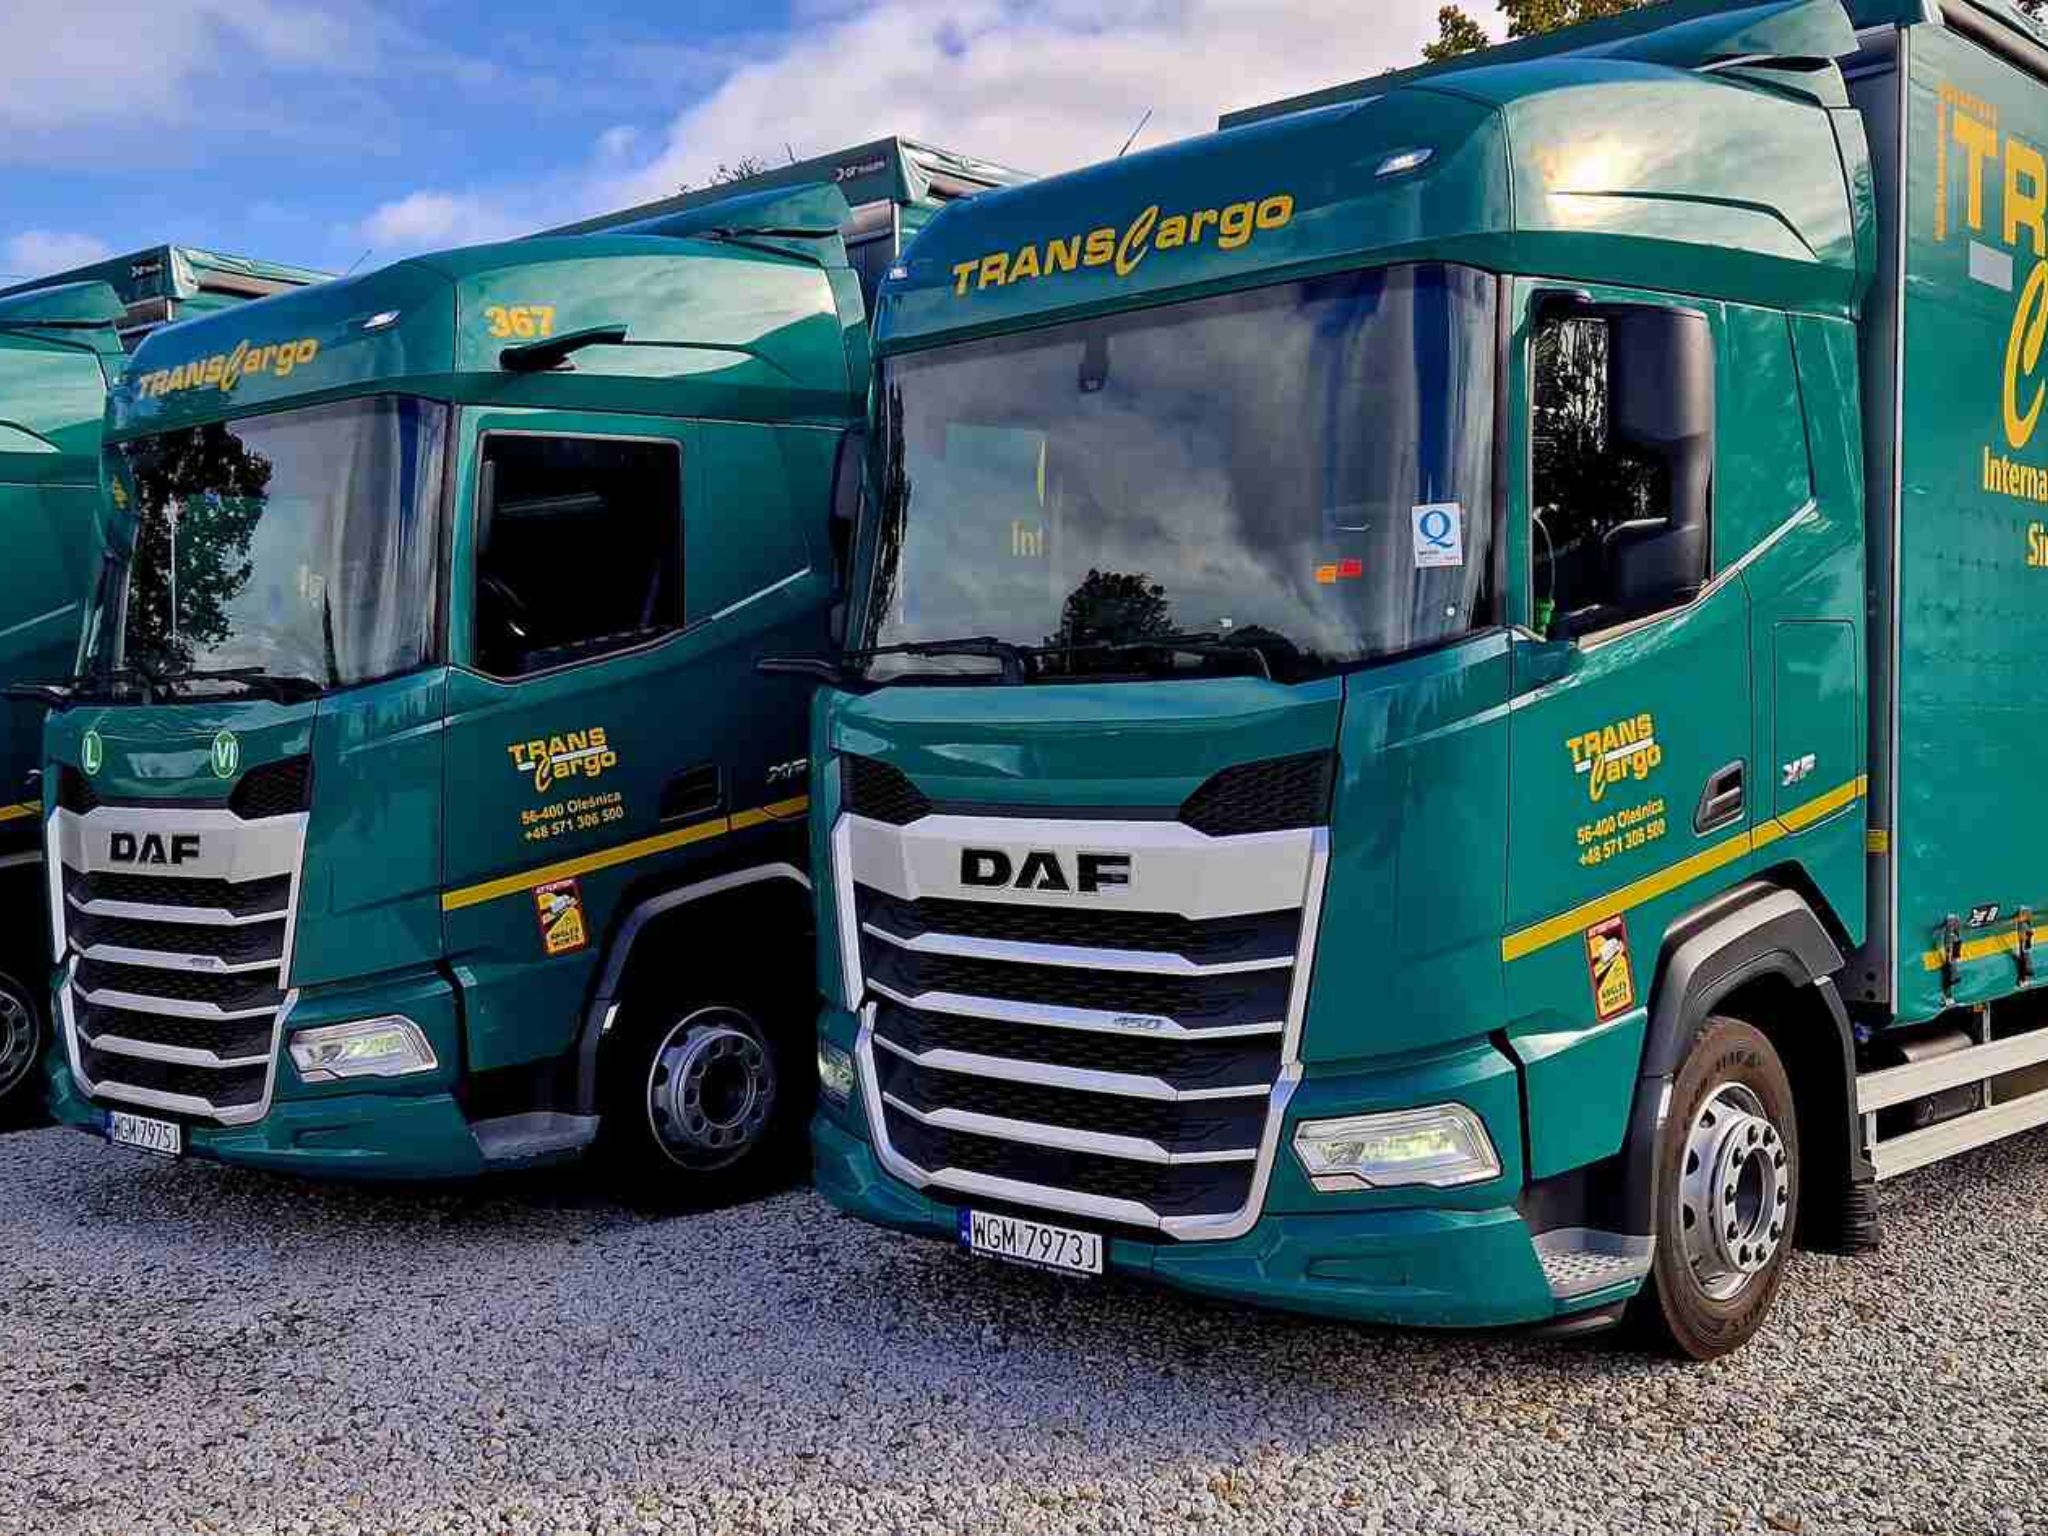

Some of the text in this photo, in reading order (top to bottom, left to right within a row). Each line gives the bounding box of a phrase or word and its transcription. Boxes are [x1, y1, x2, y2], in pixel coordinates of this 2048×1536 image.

[484, 305, 556, 338] 367
[1419, 510, 1455, 548] Q
[215, 740, 236, 768] VI
[507, 727, 607, 762] TRANS
[1565, 713, 1654, 763] TRANS
[534, 750, 617, 792] Cargo
[1589, 744, 1662, 801] Cargo
[520, 791, 622, 825] 56-400 Oleśnica
[524, 806, 624, 840] +48 571 306 500
[1576, 815, 1616, 845] 56-400
[1579, 818, 1667, 865] +48 571 306 500
[110, 832, 200, 865] DAF
[960, 848, 1131, 893] DAF
[972, 1213, 1018, 1253] WGM
[1025, 1224, 1097, 1269] 7973J
